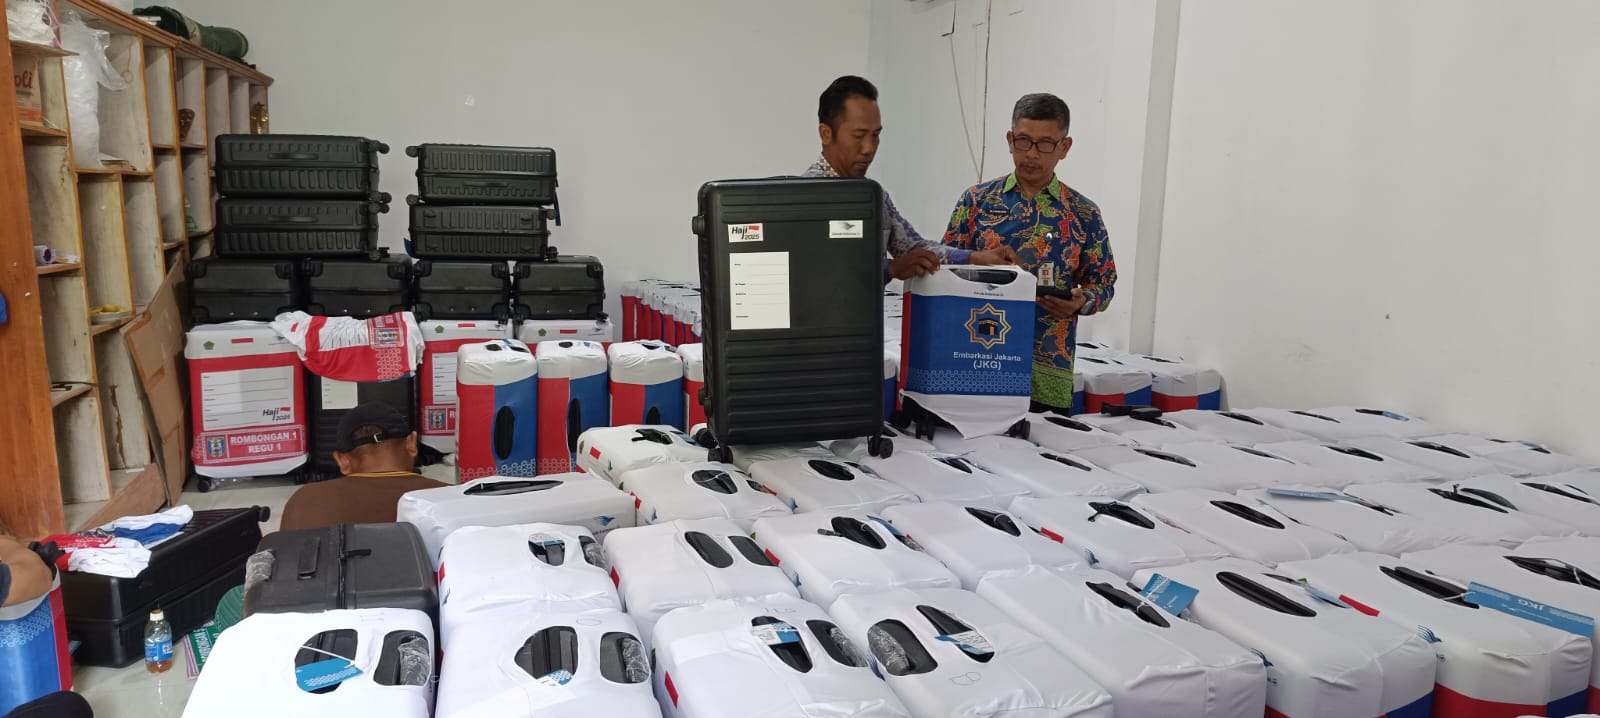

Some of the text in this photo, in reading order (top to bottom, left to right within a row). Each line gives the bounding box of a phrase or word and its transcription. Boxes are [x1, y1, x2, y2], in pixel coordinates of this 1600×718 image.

[731, 225, 748, 240] Haji
[953, 351, 1022, 362] Embarkasi Jakarta
[973, 360, 1002, 371] (JKG)
[263, 407, 279, 421] Haji
[230, 432, 290, 445] ROMBONGAN
[248, 443, 274, 454] REGU
[1517, 598, 1545, 611] JKG
